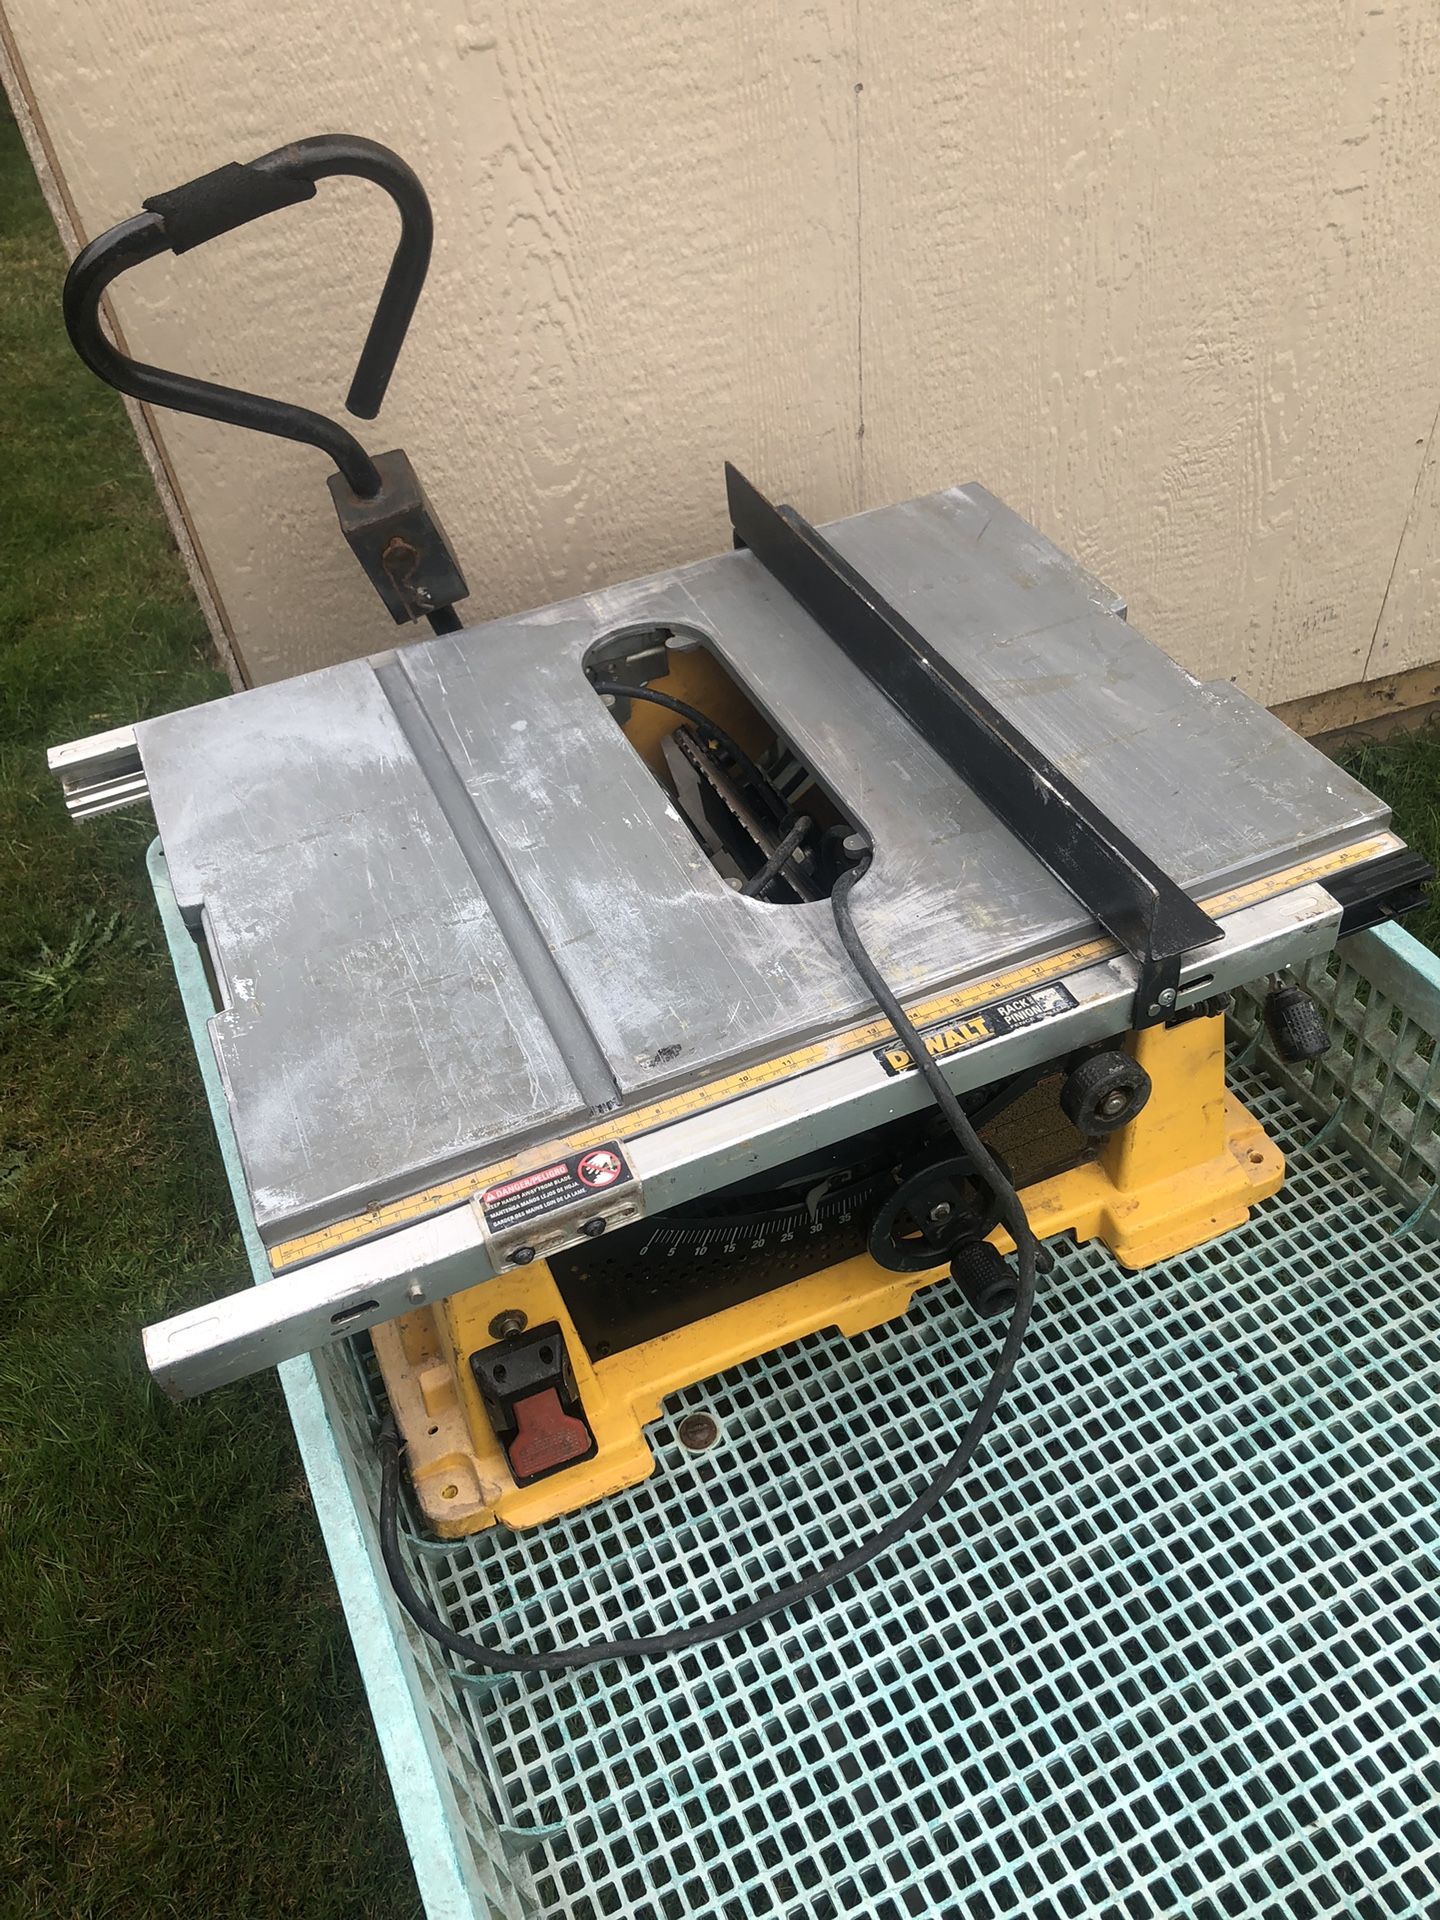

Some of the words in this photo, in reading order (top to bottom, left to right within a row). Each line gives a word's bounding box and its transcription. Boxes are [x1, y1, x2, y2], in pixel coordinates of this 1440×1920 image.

[997, 998, 1030, 1016] RACK
[1004, 1005, 1043, 1025] PINION
[885, 1018, 989, 1069] DWALT
[496, 1166, 566, 1198] DANGER/PELIGRO
[490, 1204, 520, 1219] MANTENGA
[540, 1189, 557, 1200] LEJOS
[556, 1187, 564, 1195] DE
[501, 1194, 522, 1206] HANDS
[525, 1204, 544, 1214] MAINS
[544, 1199, 556, 1208] LOIN
[556, 1196, 565, 1204] DE
[639, 1245, 648, 1256] 0
[667, 1247, 677, 1256] 5
[694, 1246, 708, 1256] 10
[723, 1243, 737, 1253] 15
[751, 1238, 765, 1249] 20
[780, 1231, 794, 1242] 25
[809, 1223, 823, 1234] 30
[838, 1212, 852, 1224] 35
